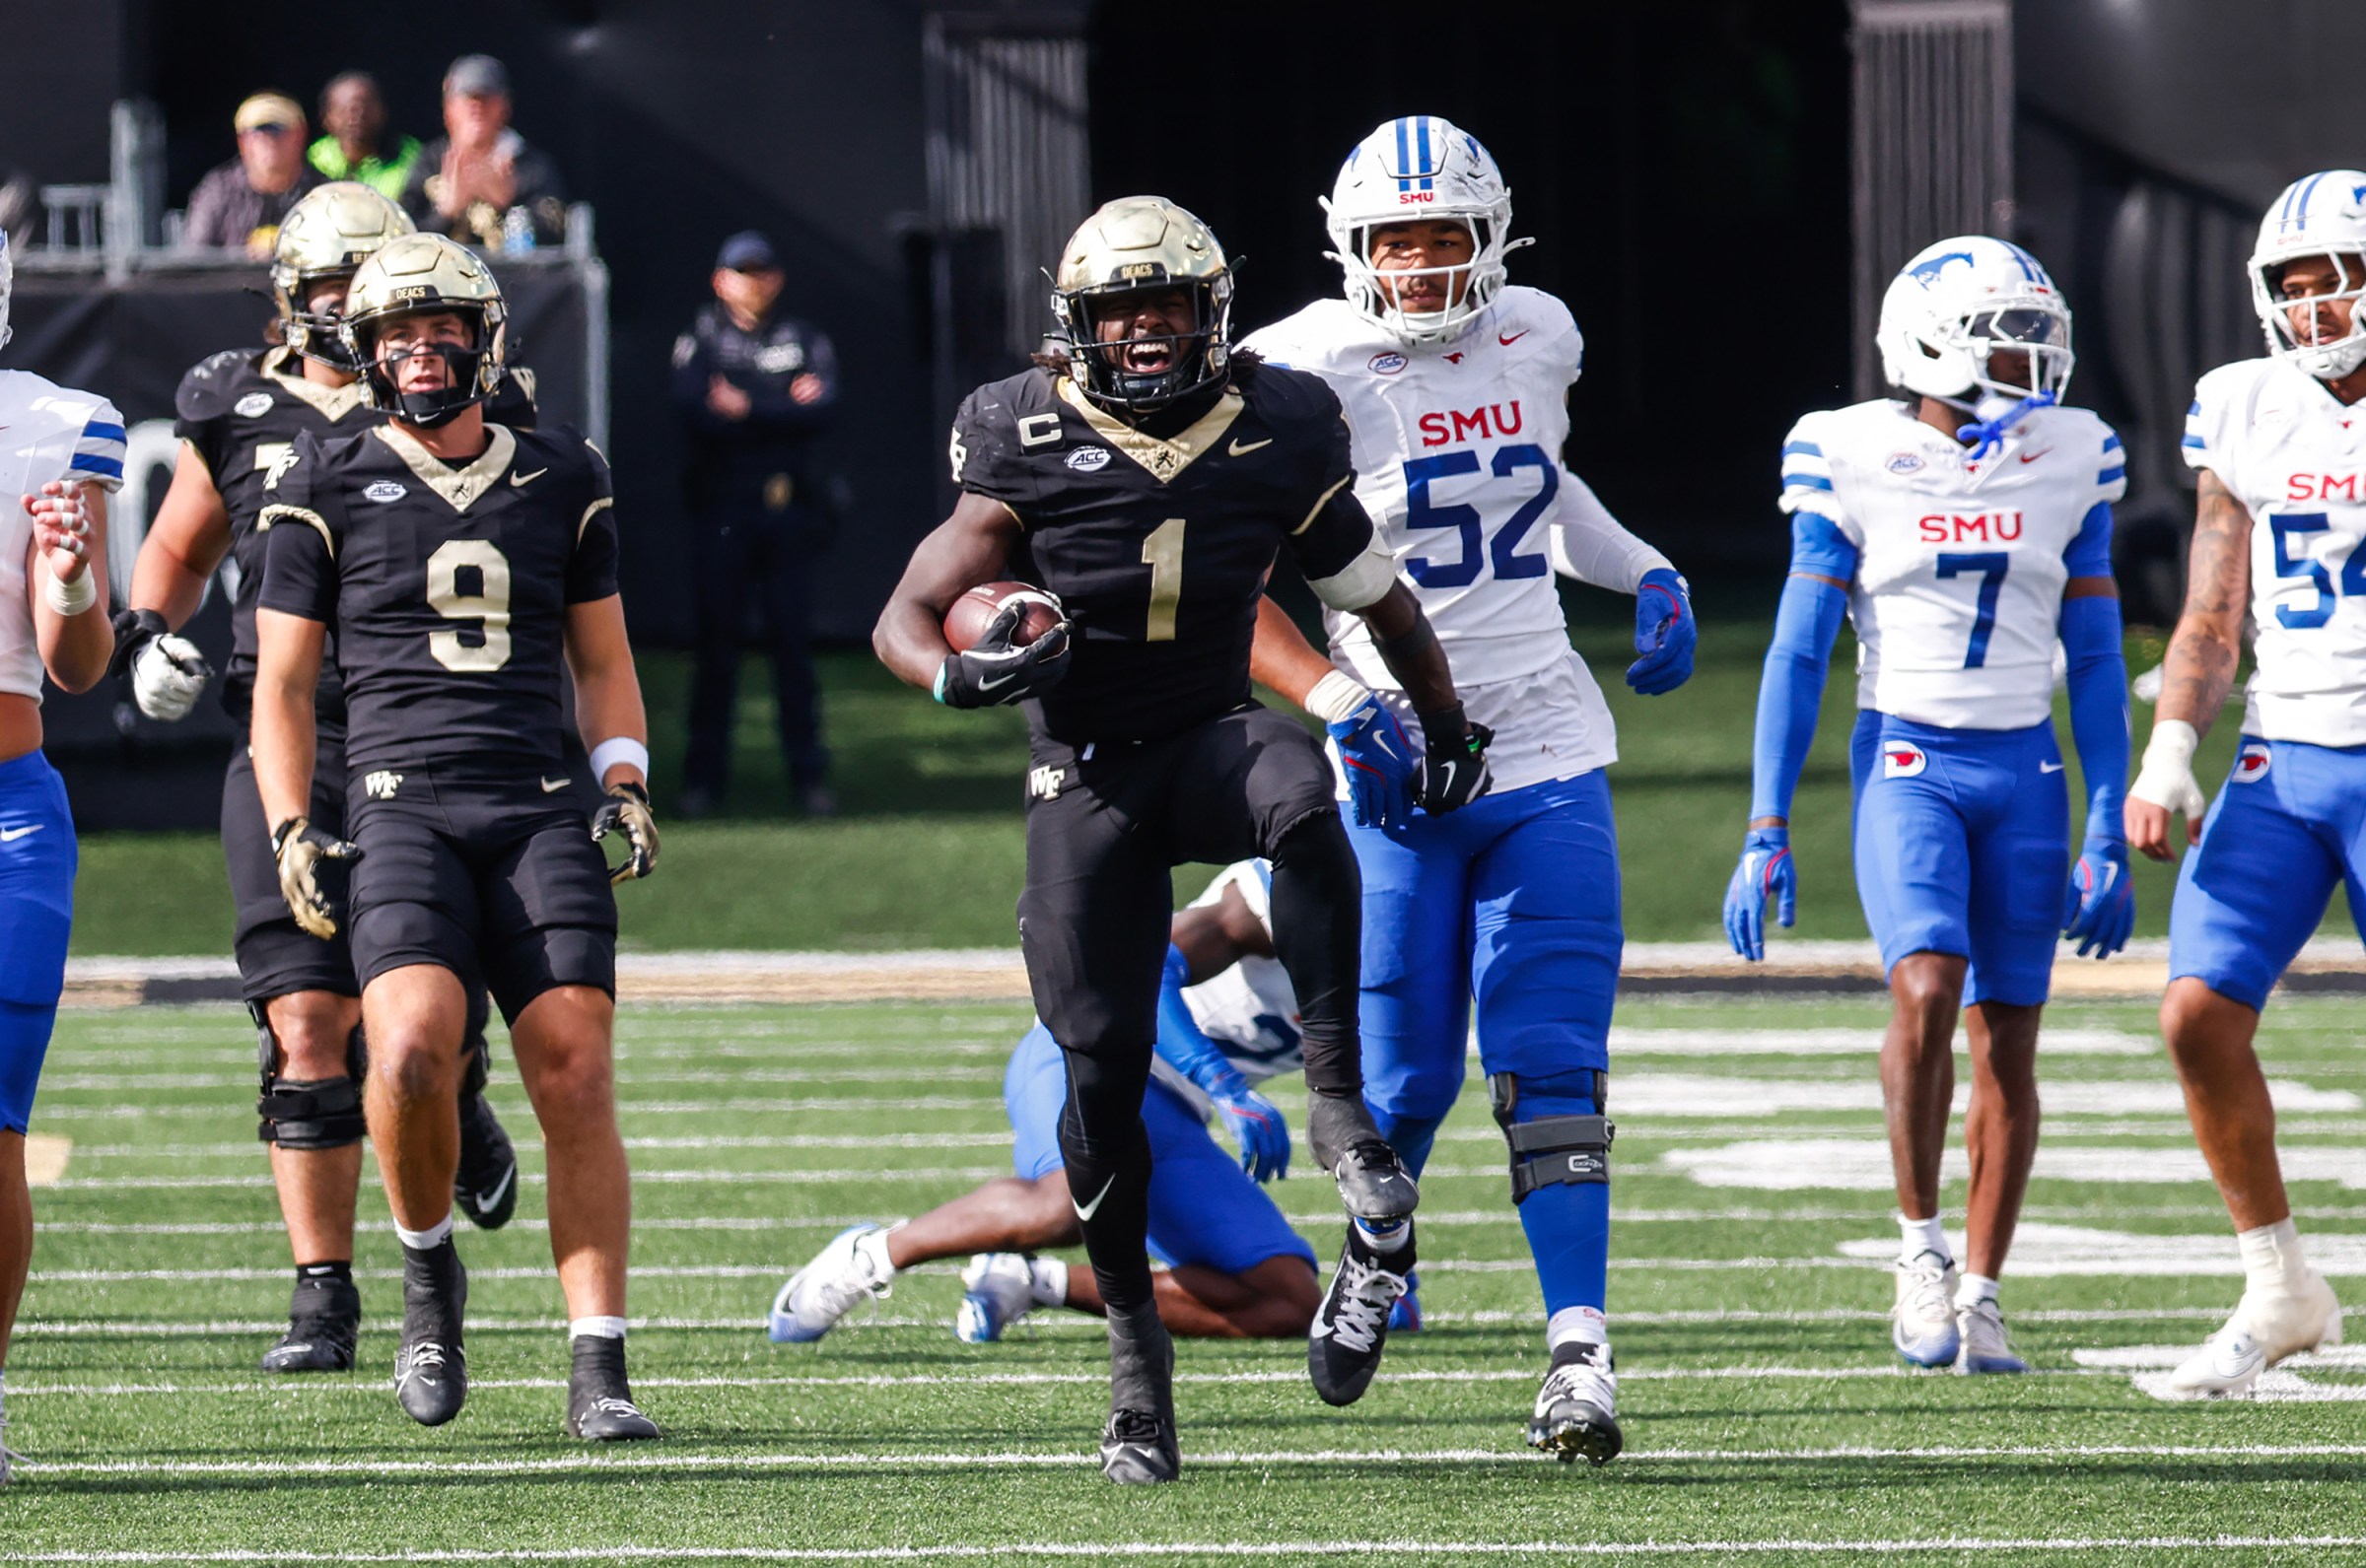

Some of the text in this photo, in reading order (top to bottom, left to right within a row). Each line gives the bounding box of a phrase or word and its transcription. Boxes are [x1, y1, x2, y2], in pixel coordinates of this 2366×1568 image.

[1399, 191, 1433, 204] SMU
[1121, 263, 1153, 280] DEACS
[396, 287, 425, 300] DEACS
[1018, 412, 1062, 446] C
[1419, 400, 1522, 447] SMU
[1075, 450, 1105, 465] ACC
[371, 485, 400, 496] ACC
[2287, 471, 2366, 501] SM
[1403, 443, 1559, 588] 52
[1919, 511, 2023, 543] SMU
[1142, 518, 1186, 642] 1
[427, 539, 512, 672] 9
[1936, 552, 2009, 669] 7
[365, 770, 403, 799] WF
[1030, 764, 1065, 800] WF
